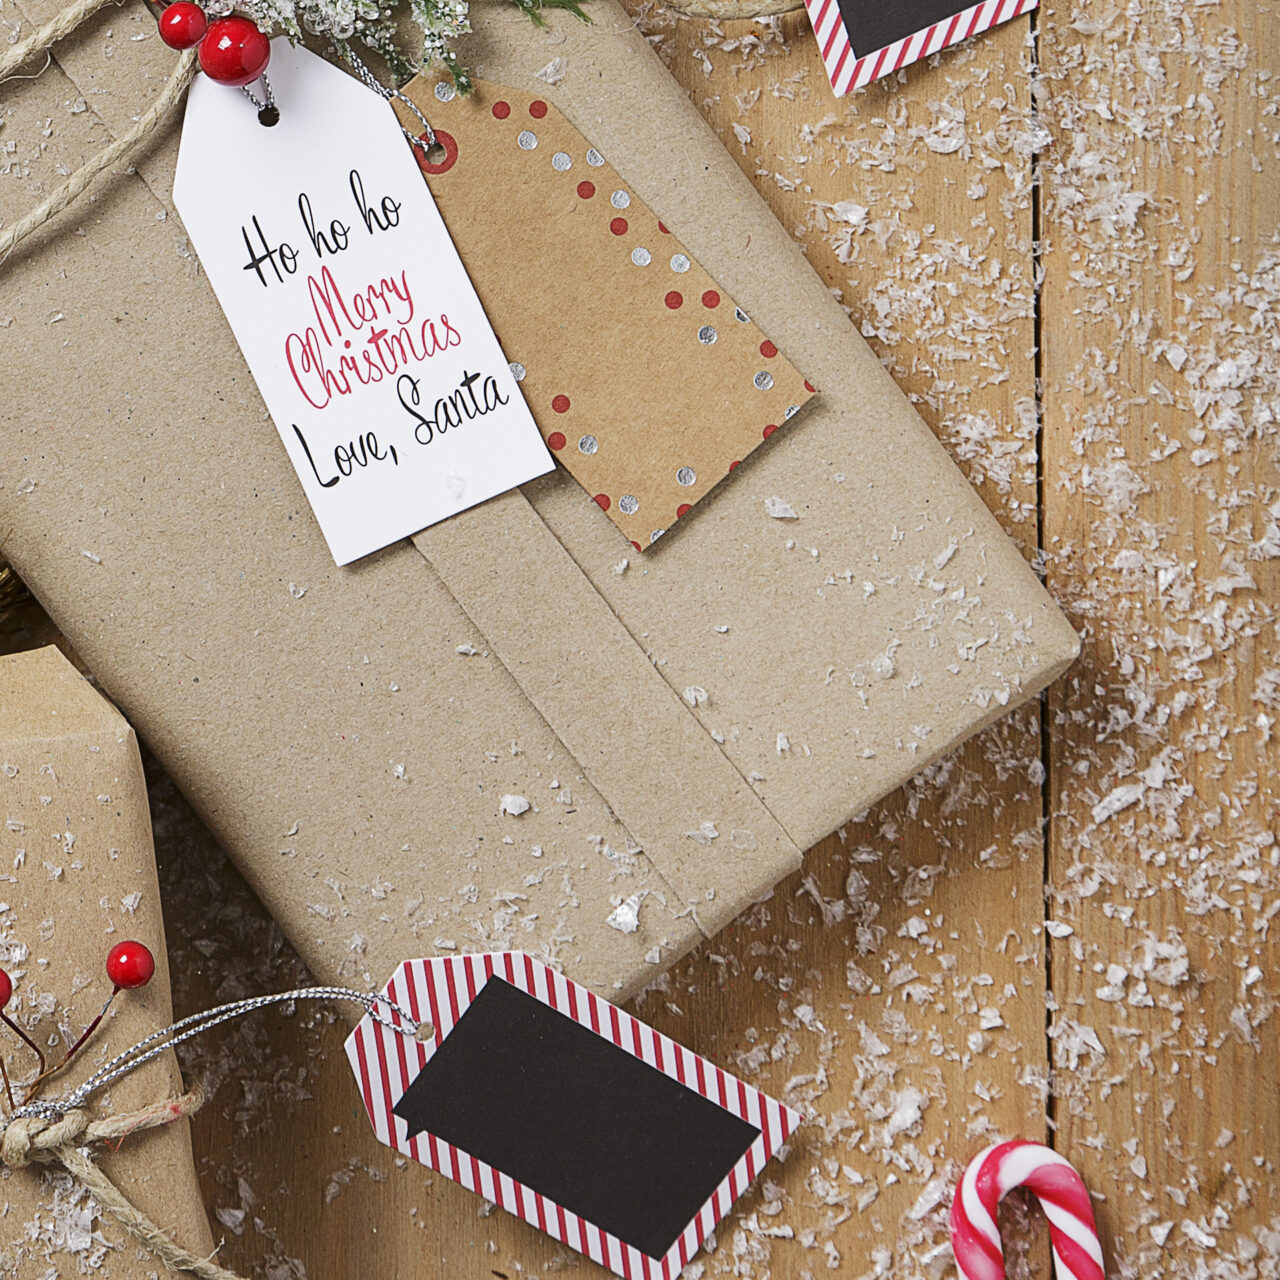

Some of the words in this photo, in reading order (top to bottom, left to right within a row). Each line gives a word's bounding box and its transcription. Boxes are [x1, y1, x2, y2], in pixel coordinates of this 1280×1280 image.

[242, 214, 299, 287] Ho
[298, 193, 350, 258] ho
[349, 169, 402, 235] ho
[307, 265, 414, 347] Merry
[285, 314, 462, 409] Christmas
[291, 423, 398, 488] Love,
[396, 370, 510, 445] Santa
